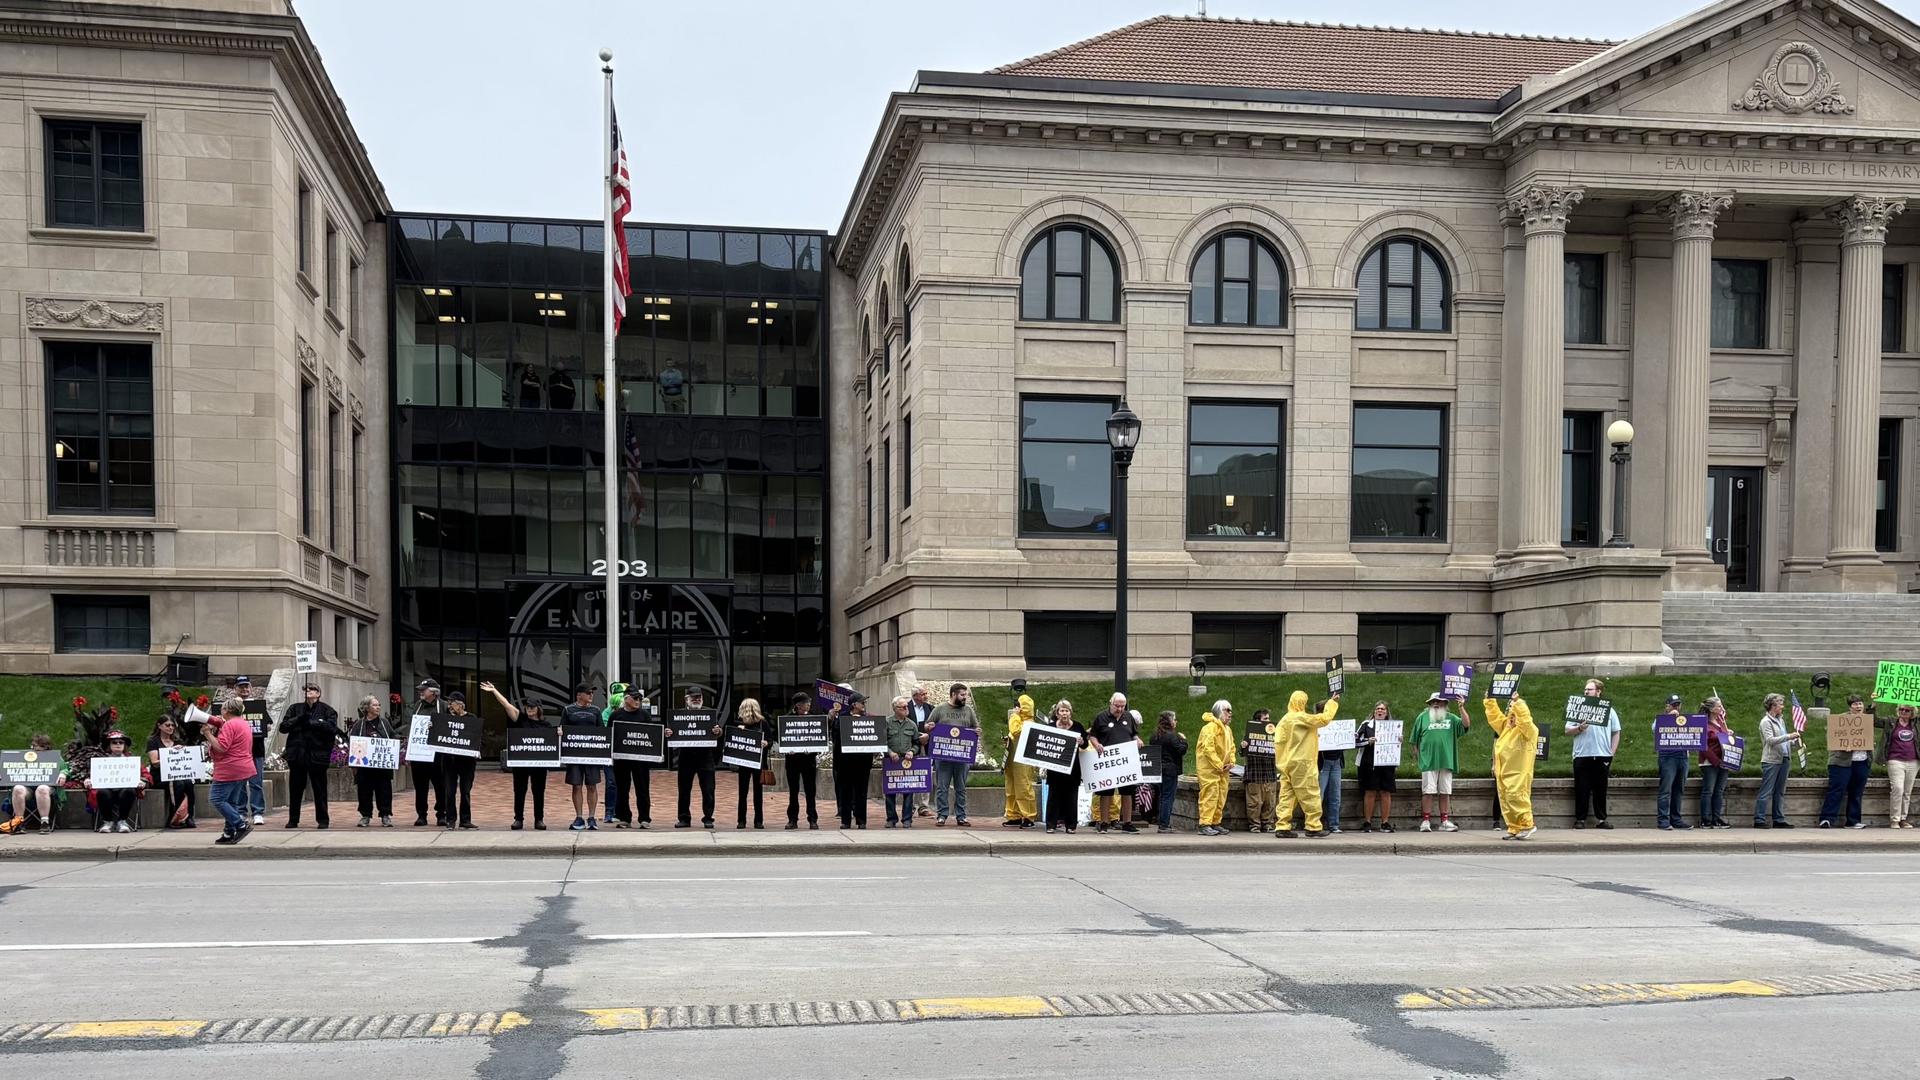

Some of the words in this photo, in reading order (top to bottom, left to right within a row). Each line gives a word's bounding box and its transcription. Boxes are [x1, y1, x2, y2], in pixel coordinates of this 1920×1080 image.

[1665, 156, 1697, 170] EAU
[1704, 158, 1762, 173] CLAIRE
[1778, 161, 1838, 175] PUBLIC
[1852, 164, 1920, 178] LIBRARY
[1737, 480, 1744, 489] 6
[592, 560, 648, 577] 203
[584, 590, 607, 600] CIT
[631, 590, 652, 601] OF
[548, 608, 600, 628] EAU
[1881, 664, 1896, 674] WE
[1898, 664, 1920, 677] STAN
[1878, 676, 1894, 687] FOR
[1896, 676, 1920, 690] FREE
[1568, 695, 1586, 704] STOP
[1876, 686, 1888, 698] OF
[1891, 688, 1920, 702] SPEEC
[1566, 703, 1608, 716] BILLIONAIRE
[1566, 711, 1578, 720] TAX
[1578, 712, 1605, 724] BREAKS
[1838, 716, 1862, 727] DVO
[448, 721, 464, 730] THIS
[438, 736, 470, 746] FASCISM
[622, 739, 653, 747] CONTROL
[731, 735, 756, 745] BASELESS
[1038, 734, 1066, 745] BLOATED
[1839, 738, 1849, 747] TO
[374, 746, 392, 754] HAVE
[746, 745, 761, 754] CRIME
[1036, 741, 1066, 752] MILITARY
[372, 753, 394, 762] FREE
[1036, 749, 1062, 759] BUDGET
[1098, 748, 1120, 758] FREE
[369, 760, 396, 768] SPEECH
[1093, 757, 1128, 770] SPEECH
[1099, 779, 1112, 788] NO
[1116, 774, 1138, 784] JOKE
